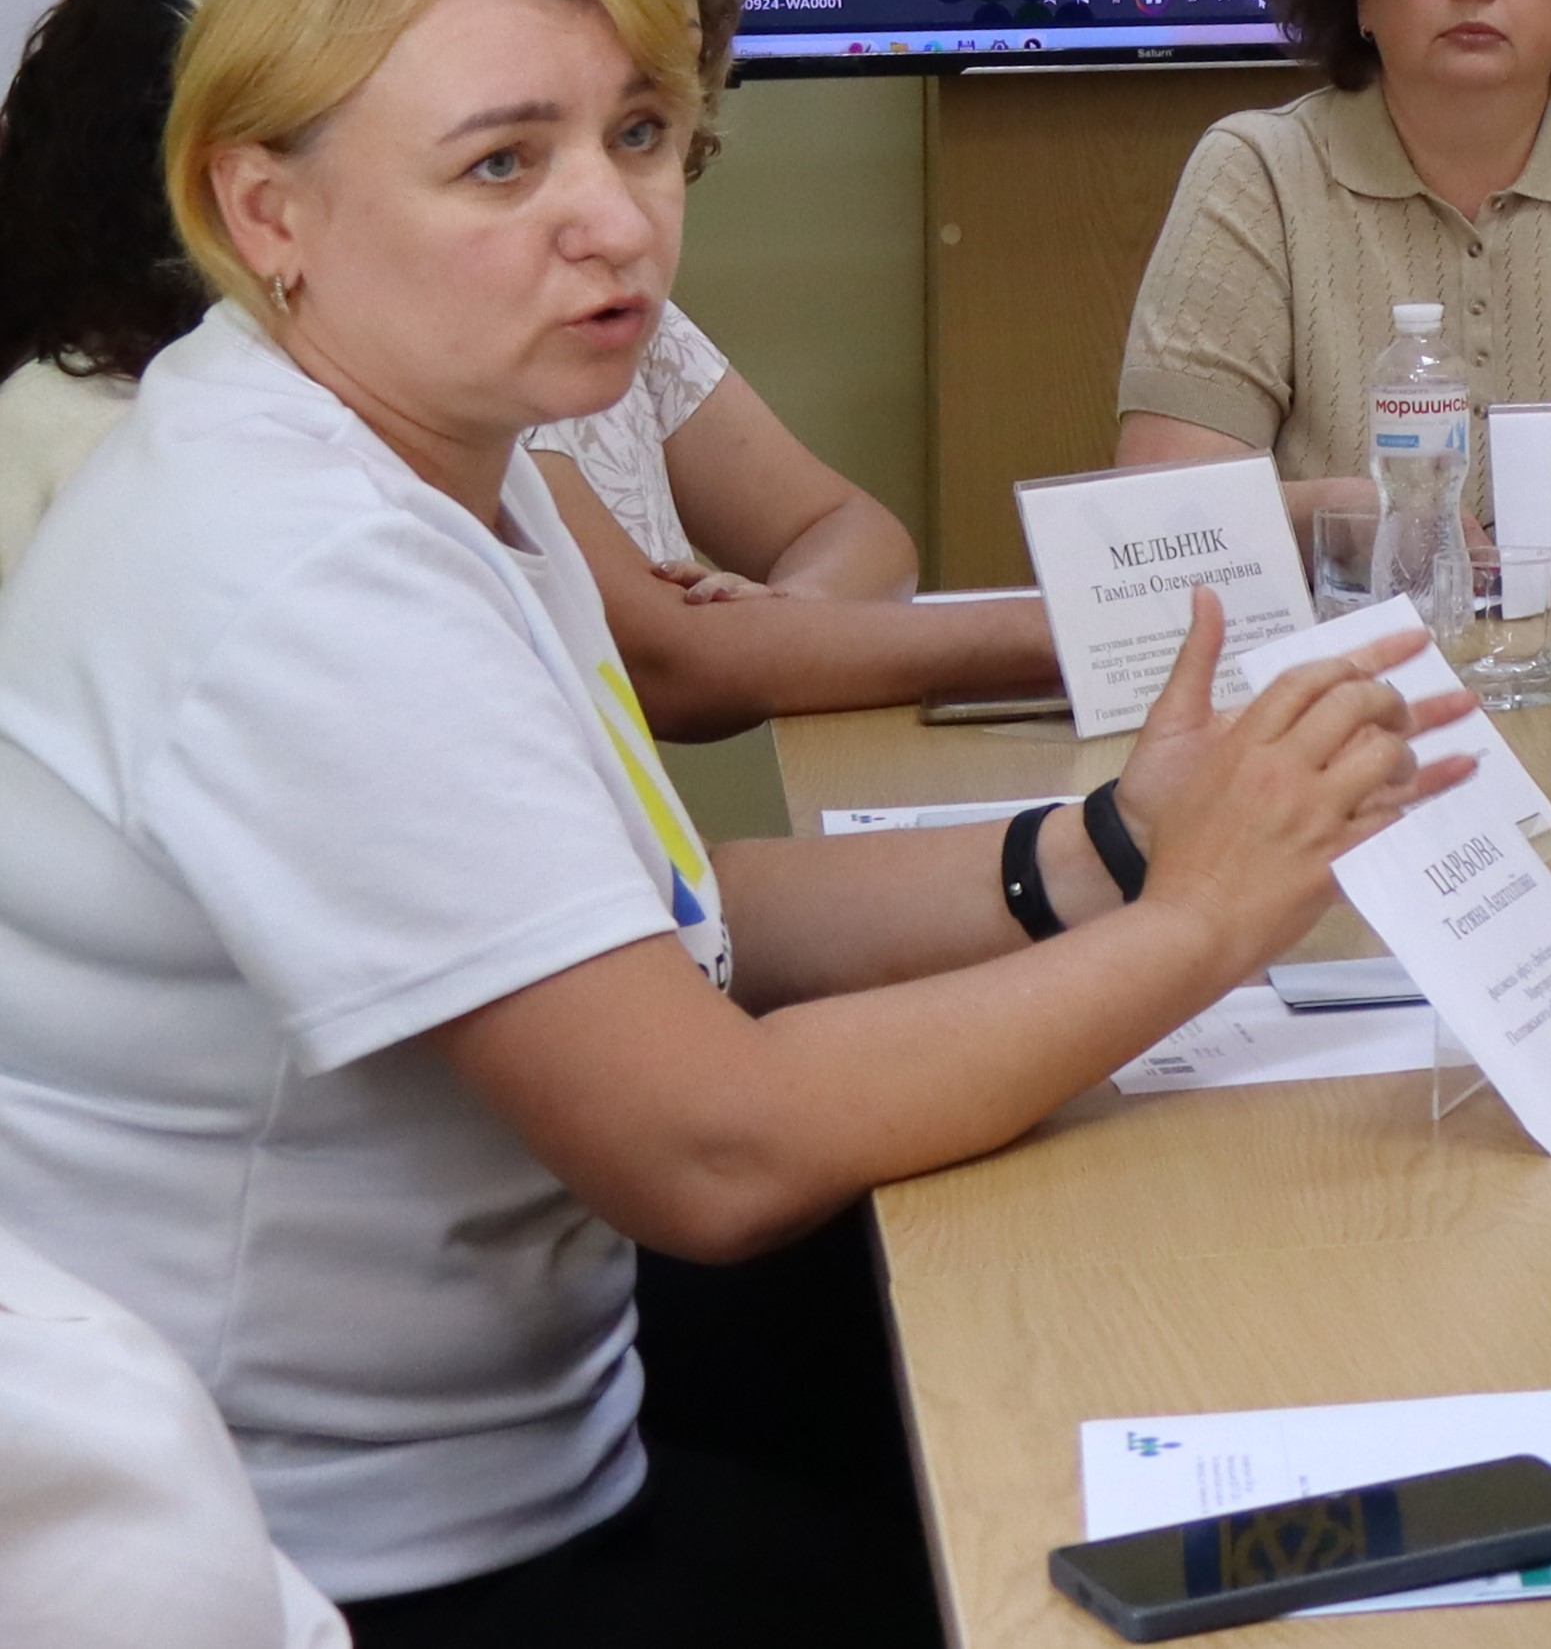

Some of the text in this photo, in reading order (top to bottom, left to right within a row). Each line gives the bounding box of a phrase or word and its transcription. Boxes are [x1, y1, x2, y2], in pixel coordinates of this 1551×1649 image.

[1375, 393, 1469, 419] моршинсь
[1109, 527, 1229, 570] МЕЛЬНИК
[1091, 559, 1263, 604] Таміла Олександрівна
[1424, 833, 1504, 896] ЦАРЬОВА
[1442, 904, 1491, 940] Тетяна
